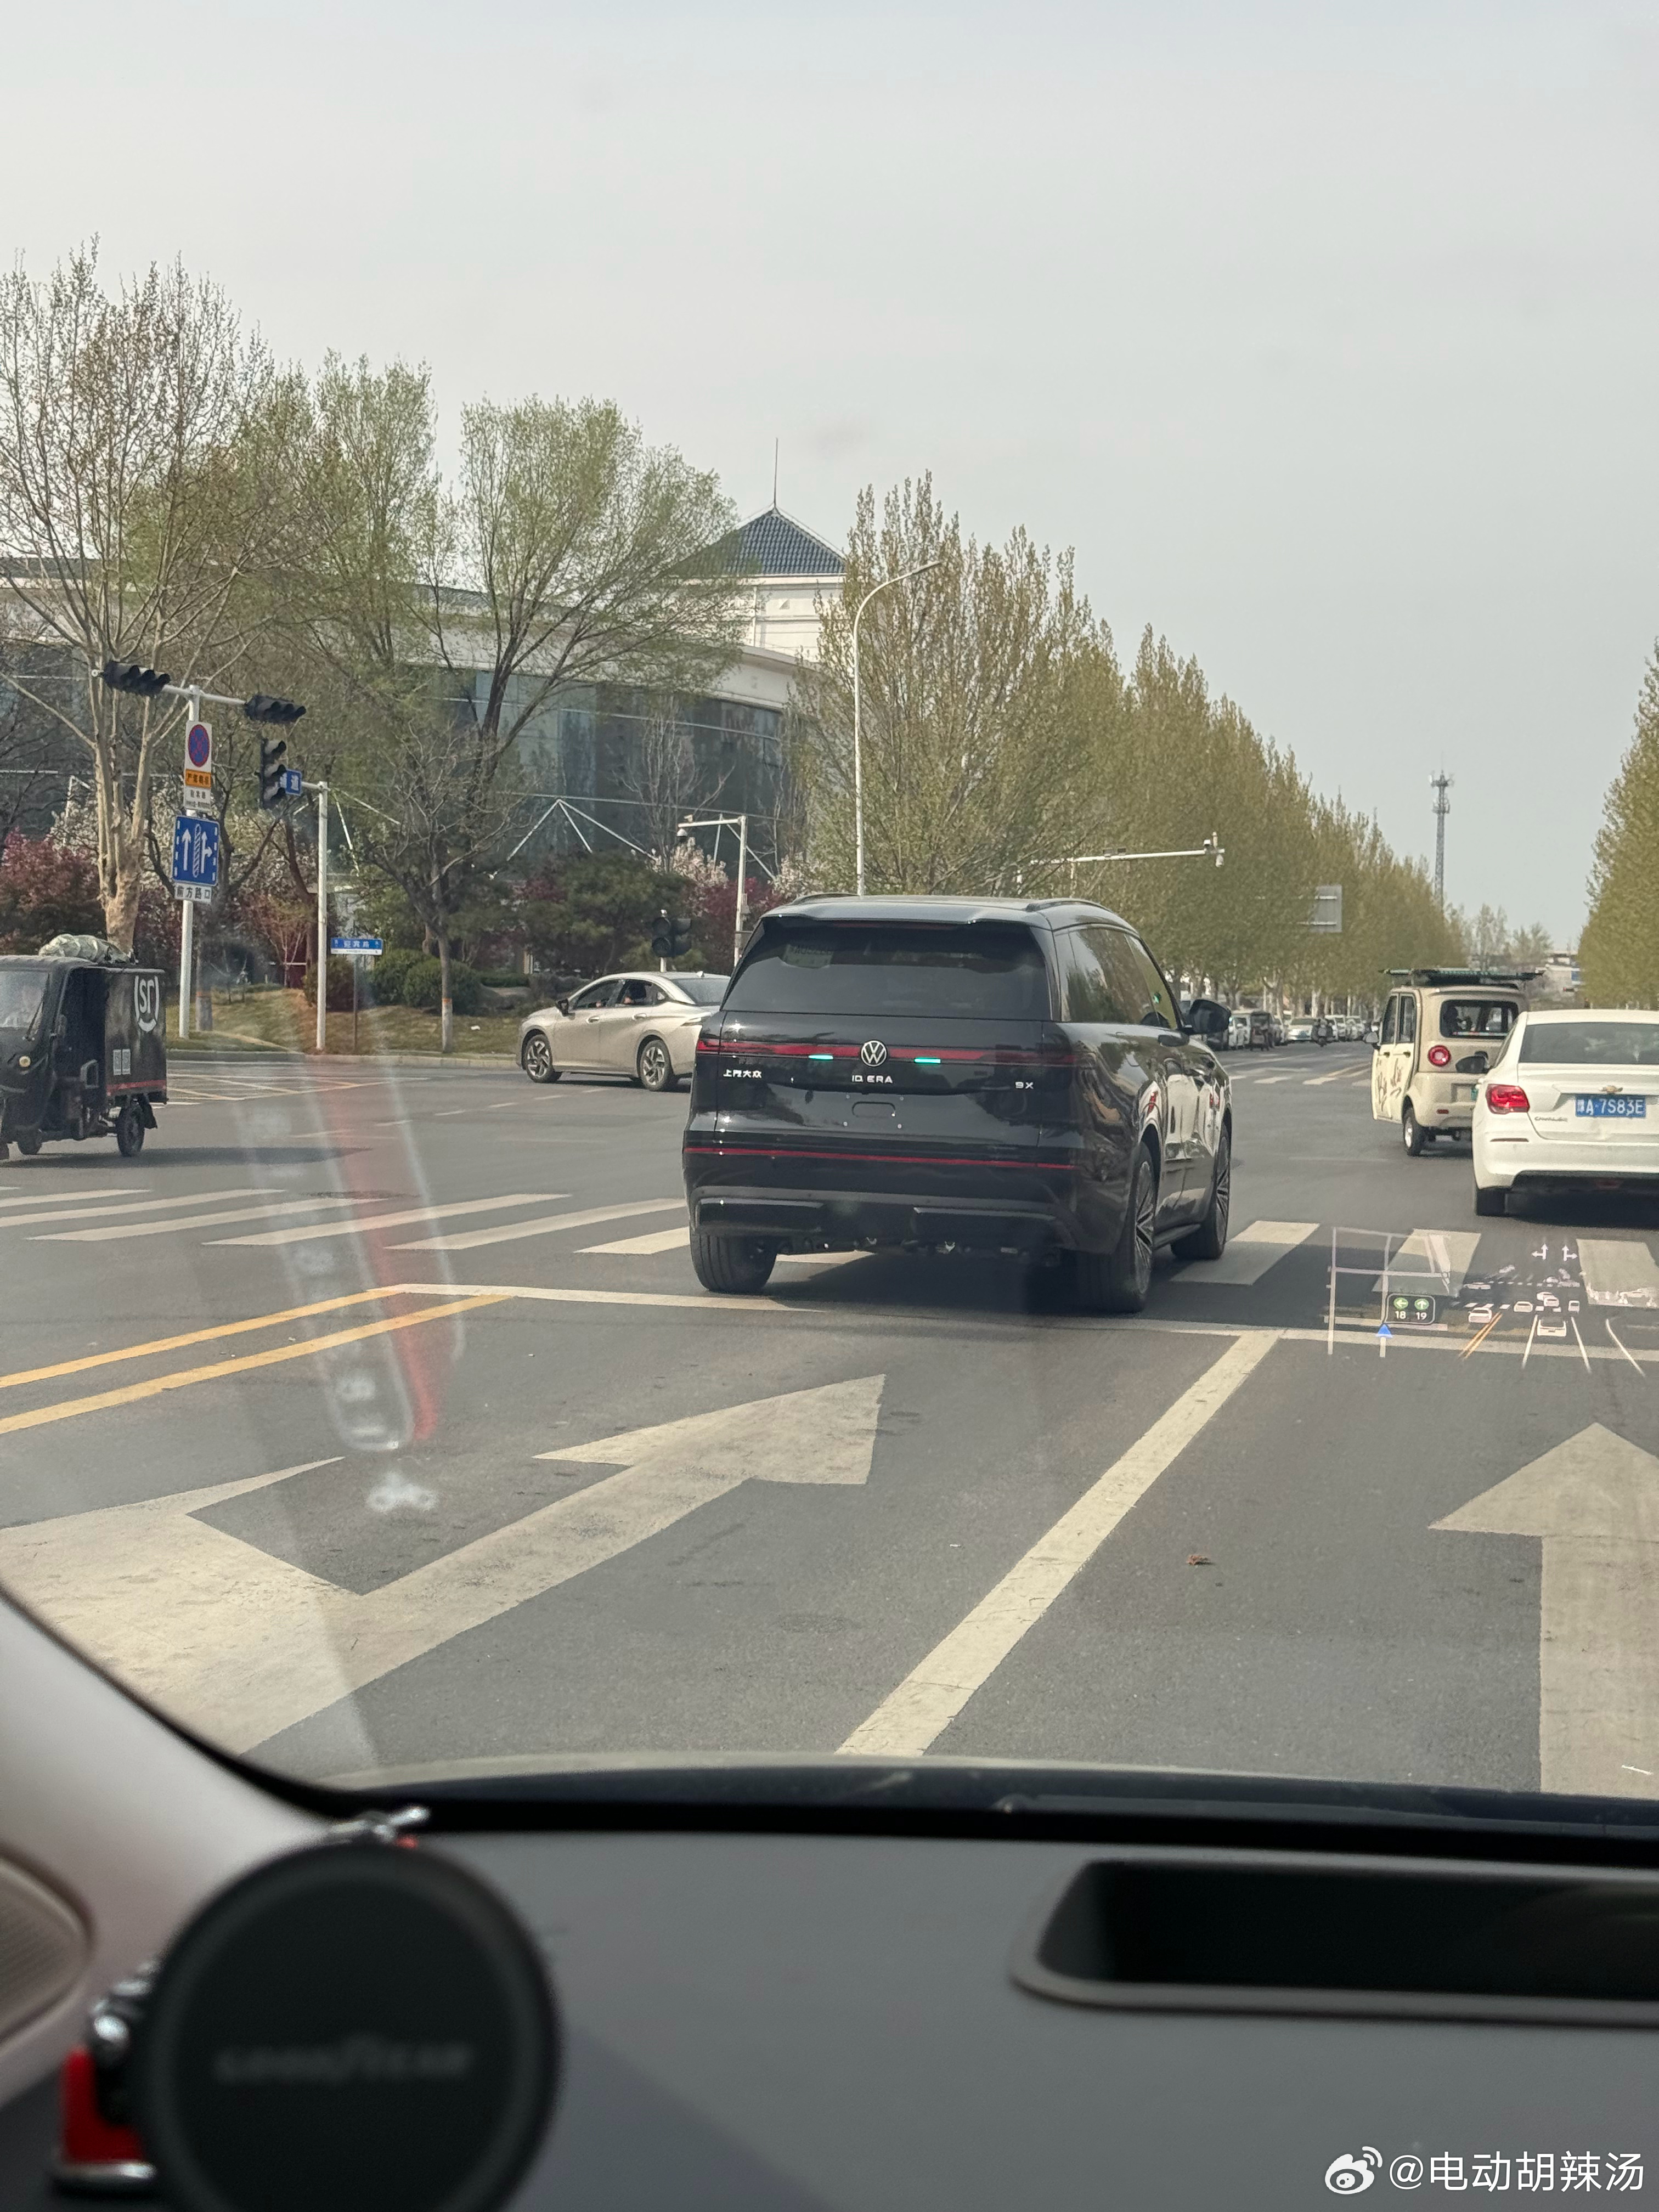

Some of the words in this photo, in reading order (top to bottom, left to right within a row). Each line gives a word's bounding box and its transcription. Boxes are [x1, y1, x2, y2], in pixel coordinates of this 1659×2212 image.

[177, 885, 211, 899] 前方路口
[723, 1069, 762, 1079] 上汽大众
[867, 1075, 893, 1084] ERA
[1015, 1081, 1034, 1090] 9X
[1395, 1311, 1406, 1319] 18
[1415, 1312, 1427, 1320] 19
